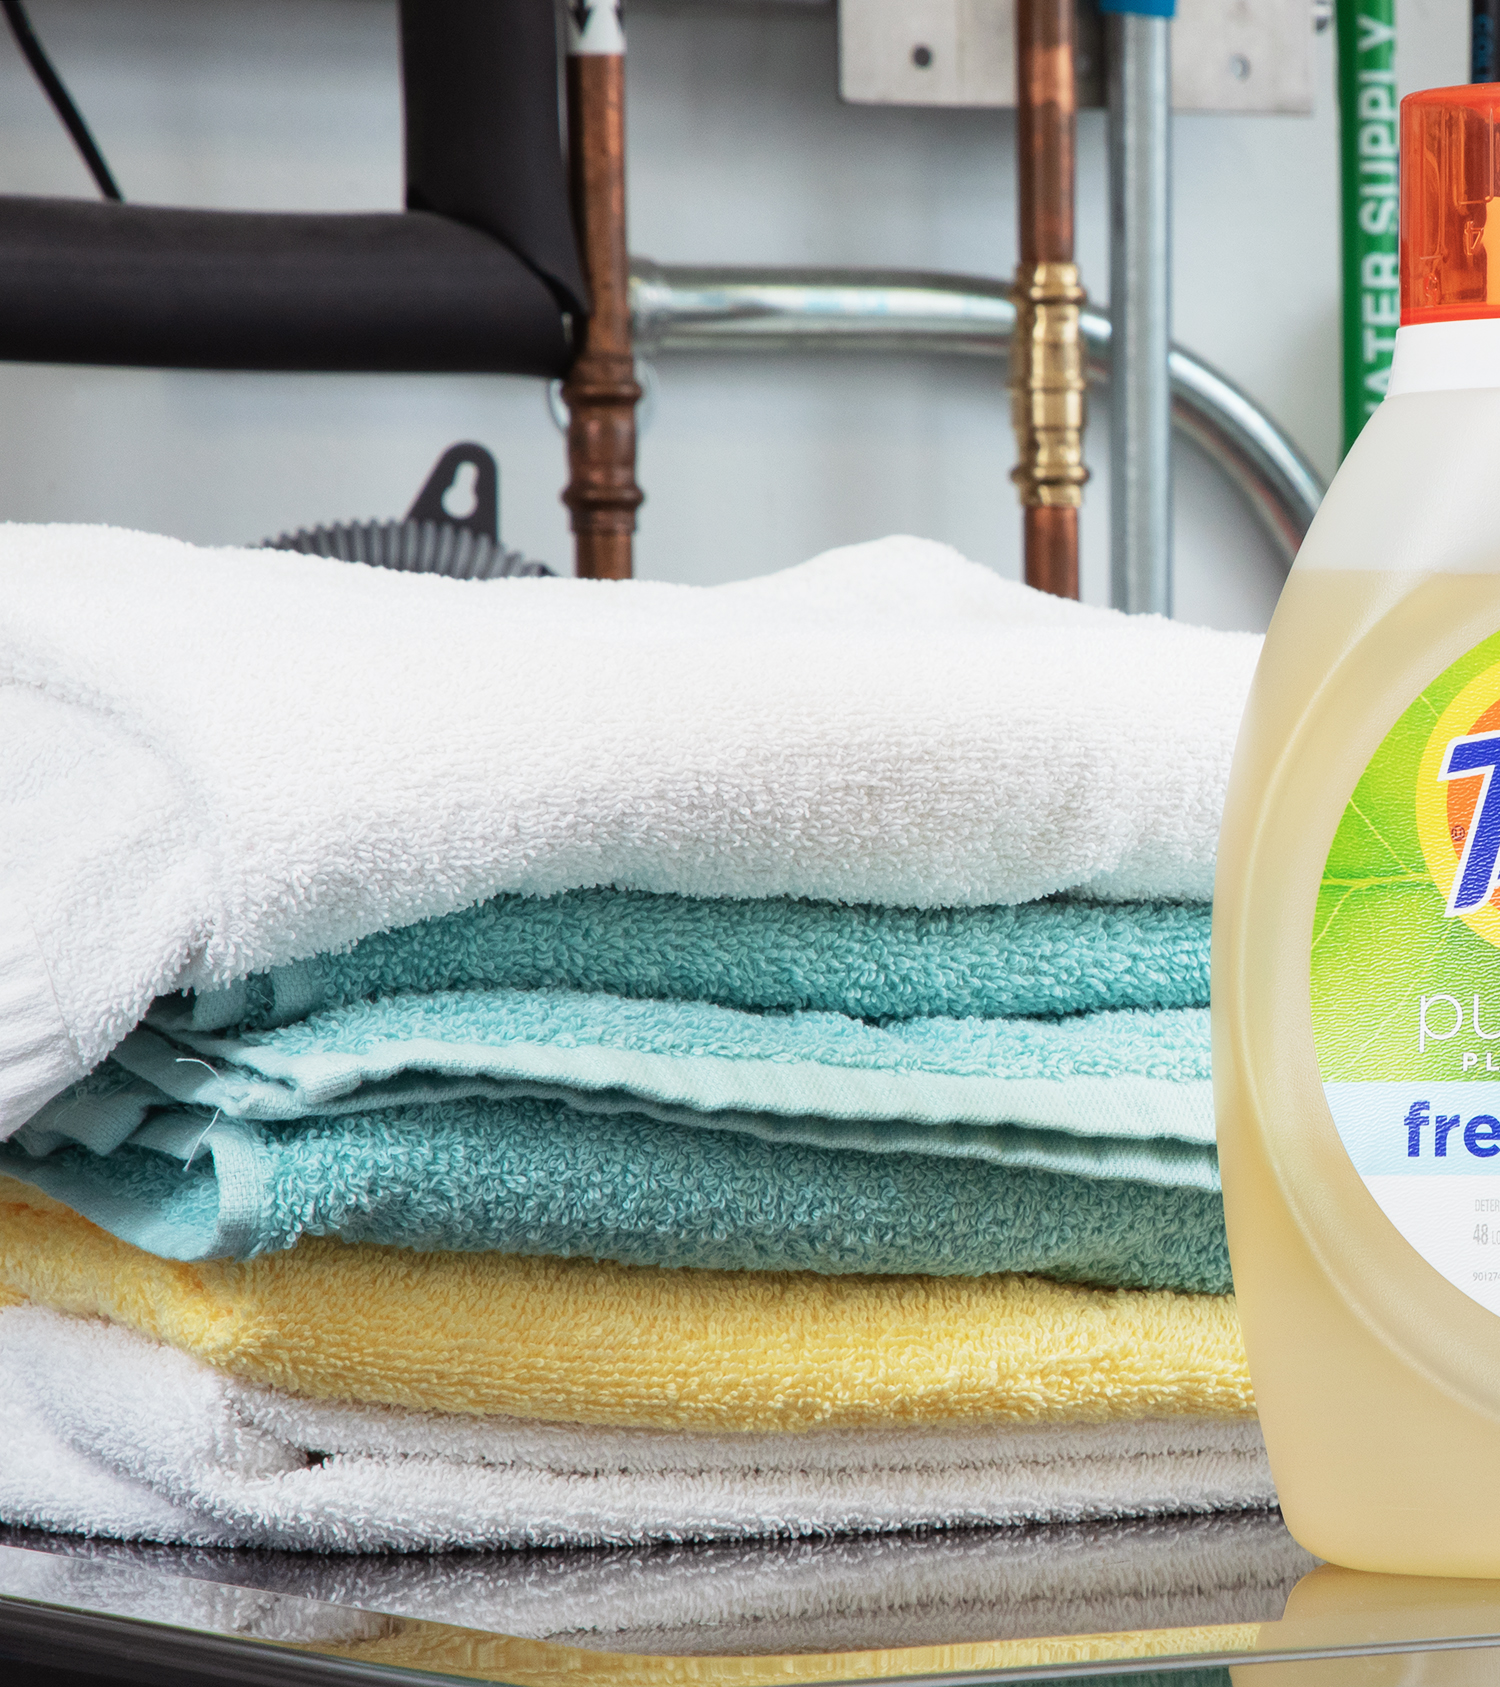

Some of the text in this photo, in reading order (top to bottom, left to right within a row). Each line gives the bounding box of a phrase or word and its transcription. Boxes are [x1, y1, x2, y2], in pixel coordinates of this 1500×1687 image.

[1358, 14, 1398, 415] ATER SUPPLY
[1473, 1224, 1489, 1245] 48
